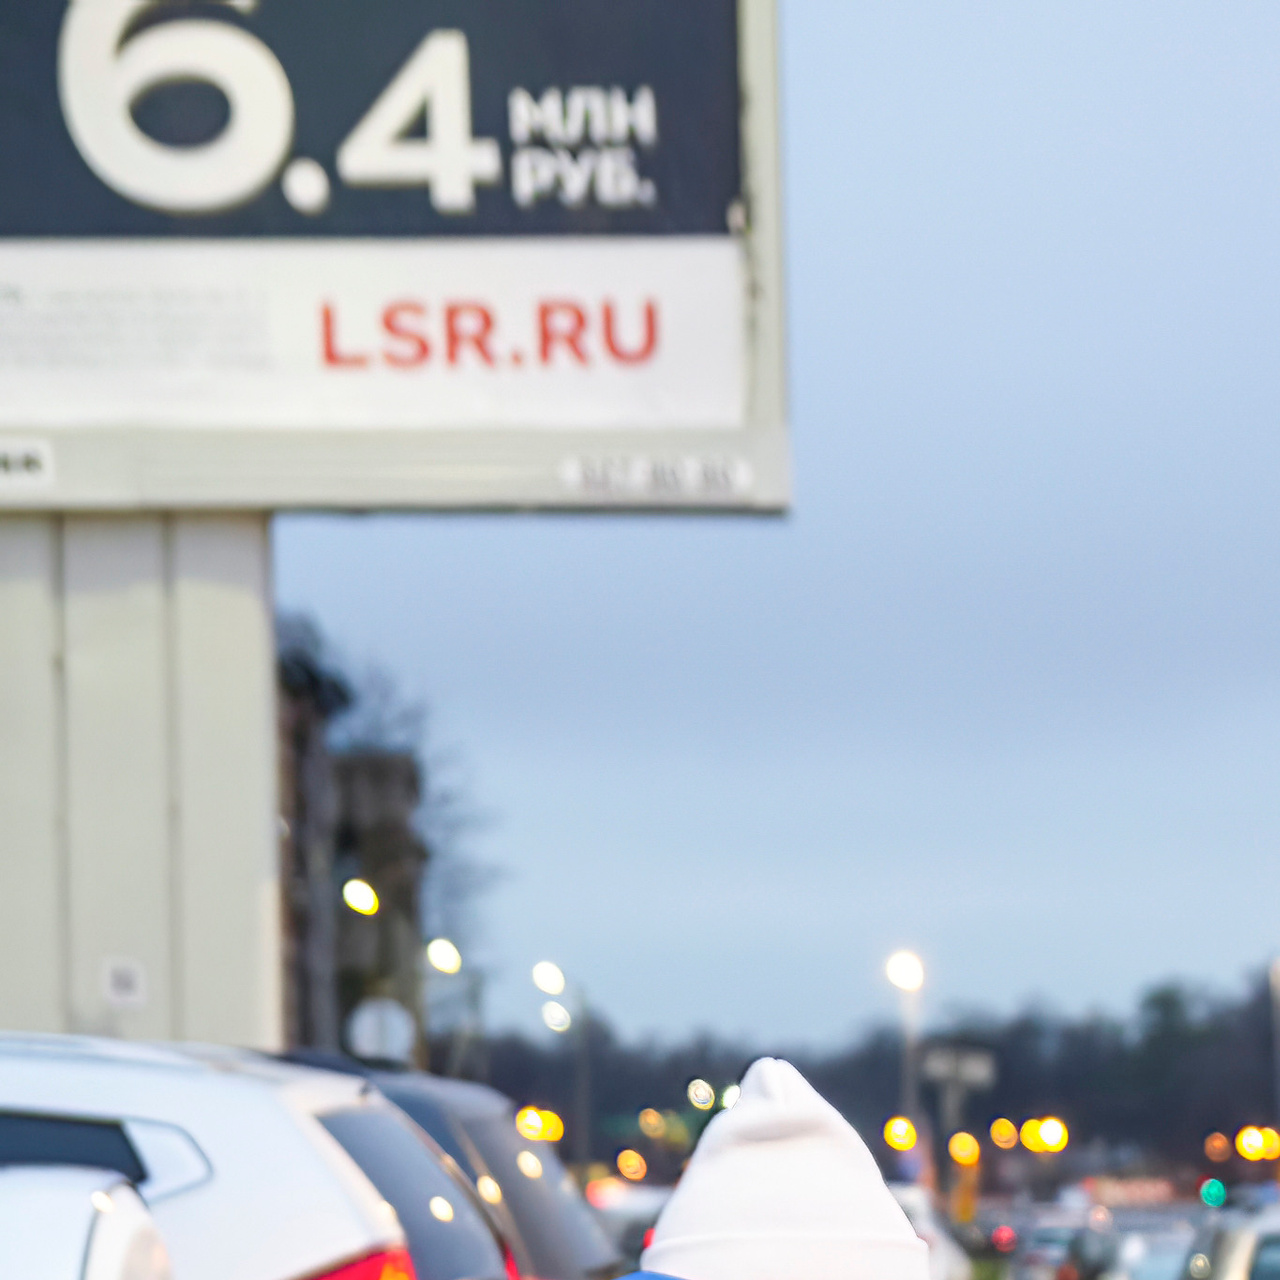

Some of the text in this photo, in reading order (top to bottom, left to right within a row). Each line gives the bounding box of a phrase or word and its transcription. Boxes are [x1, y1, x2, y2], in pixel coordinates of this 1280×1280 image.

[56, 0, 501, 213] 6.4
[508, 84, 657, 147] МЛН
[511, 147, 658, 209] РУБ.
[320, 299, 660, 369] LSR.RU
